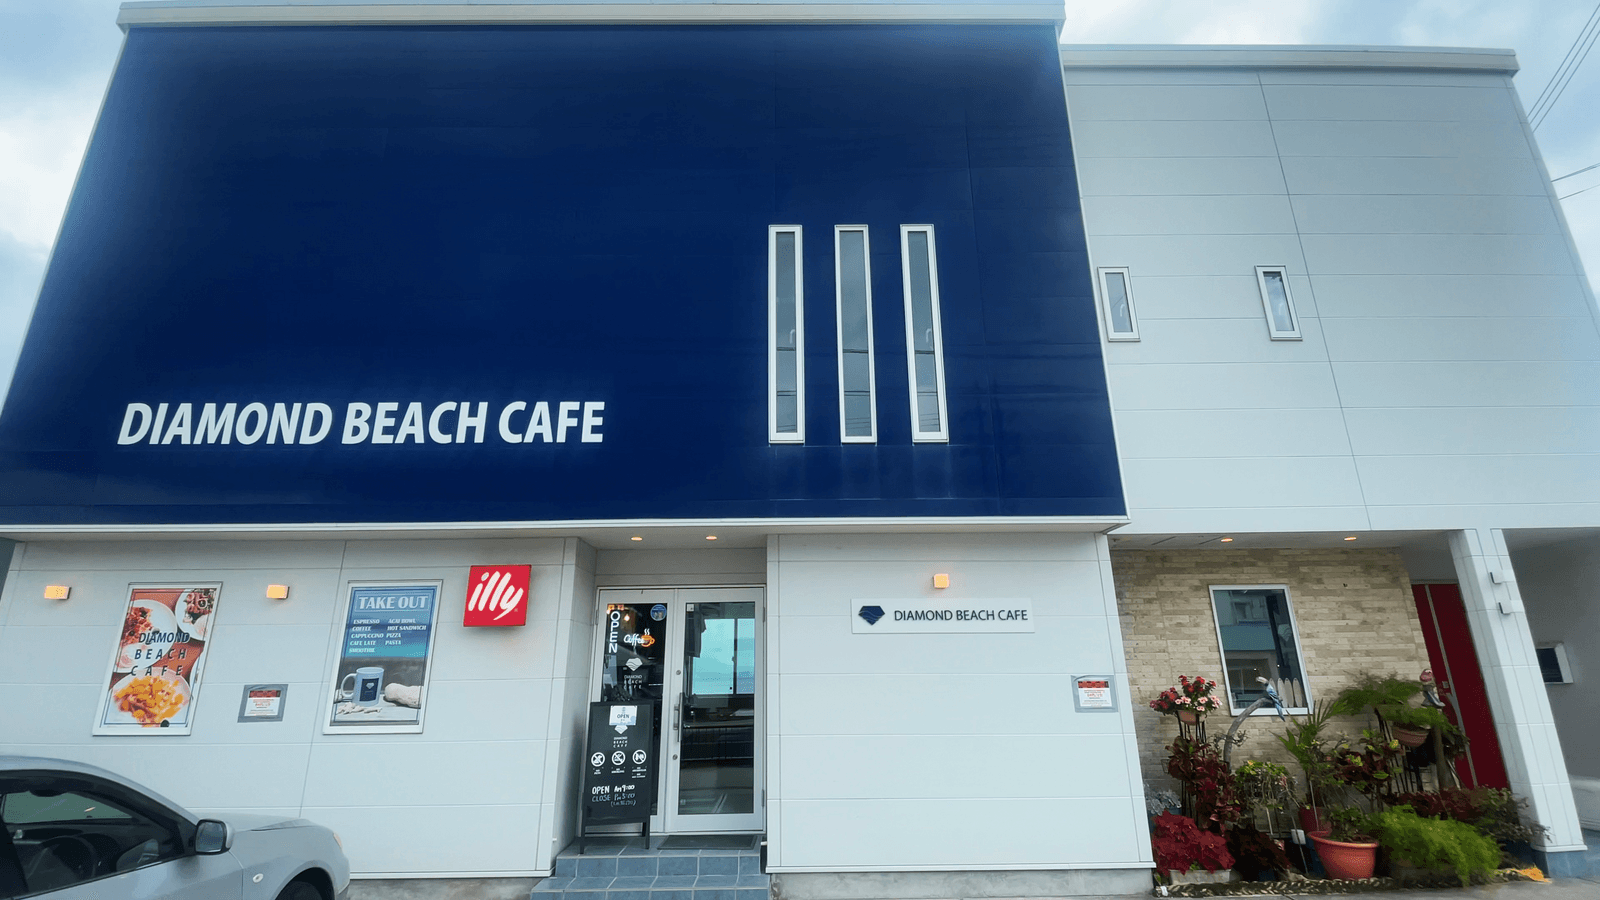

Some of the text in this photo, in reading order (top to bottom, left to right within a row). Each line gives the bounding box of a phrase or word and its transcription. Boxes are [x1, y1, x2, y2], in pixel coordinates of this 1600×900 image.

[117, 401, 606, 446] DIAMOND BEACH CAFE
[468, 571, 524, 620] illy
[359, 596, 428, 609] TAKE OUT
[894, 610, 1028, 621] DIAMOND BEACH CAFE
[608, 611, 620, 653] OPEN
[139, 633, 189, 643] DIAMOND
[135, 649, 186, 659] BEACH
[131, 665, 183, 676] CAFE
[592, 786, 610, 794] OPEN
[592, 794, 610, 802] CLOSE
